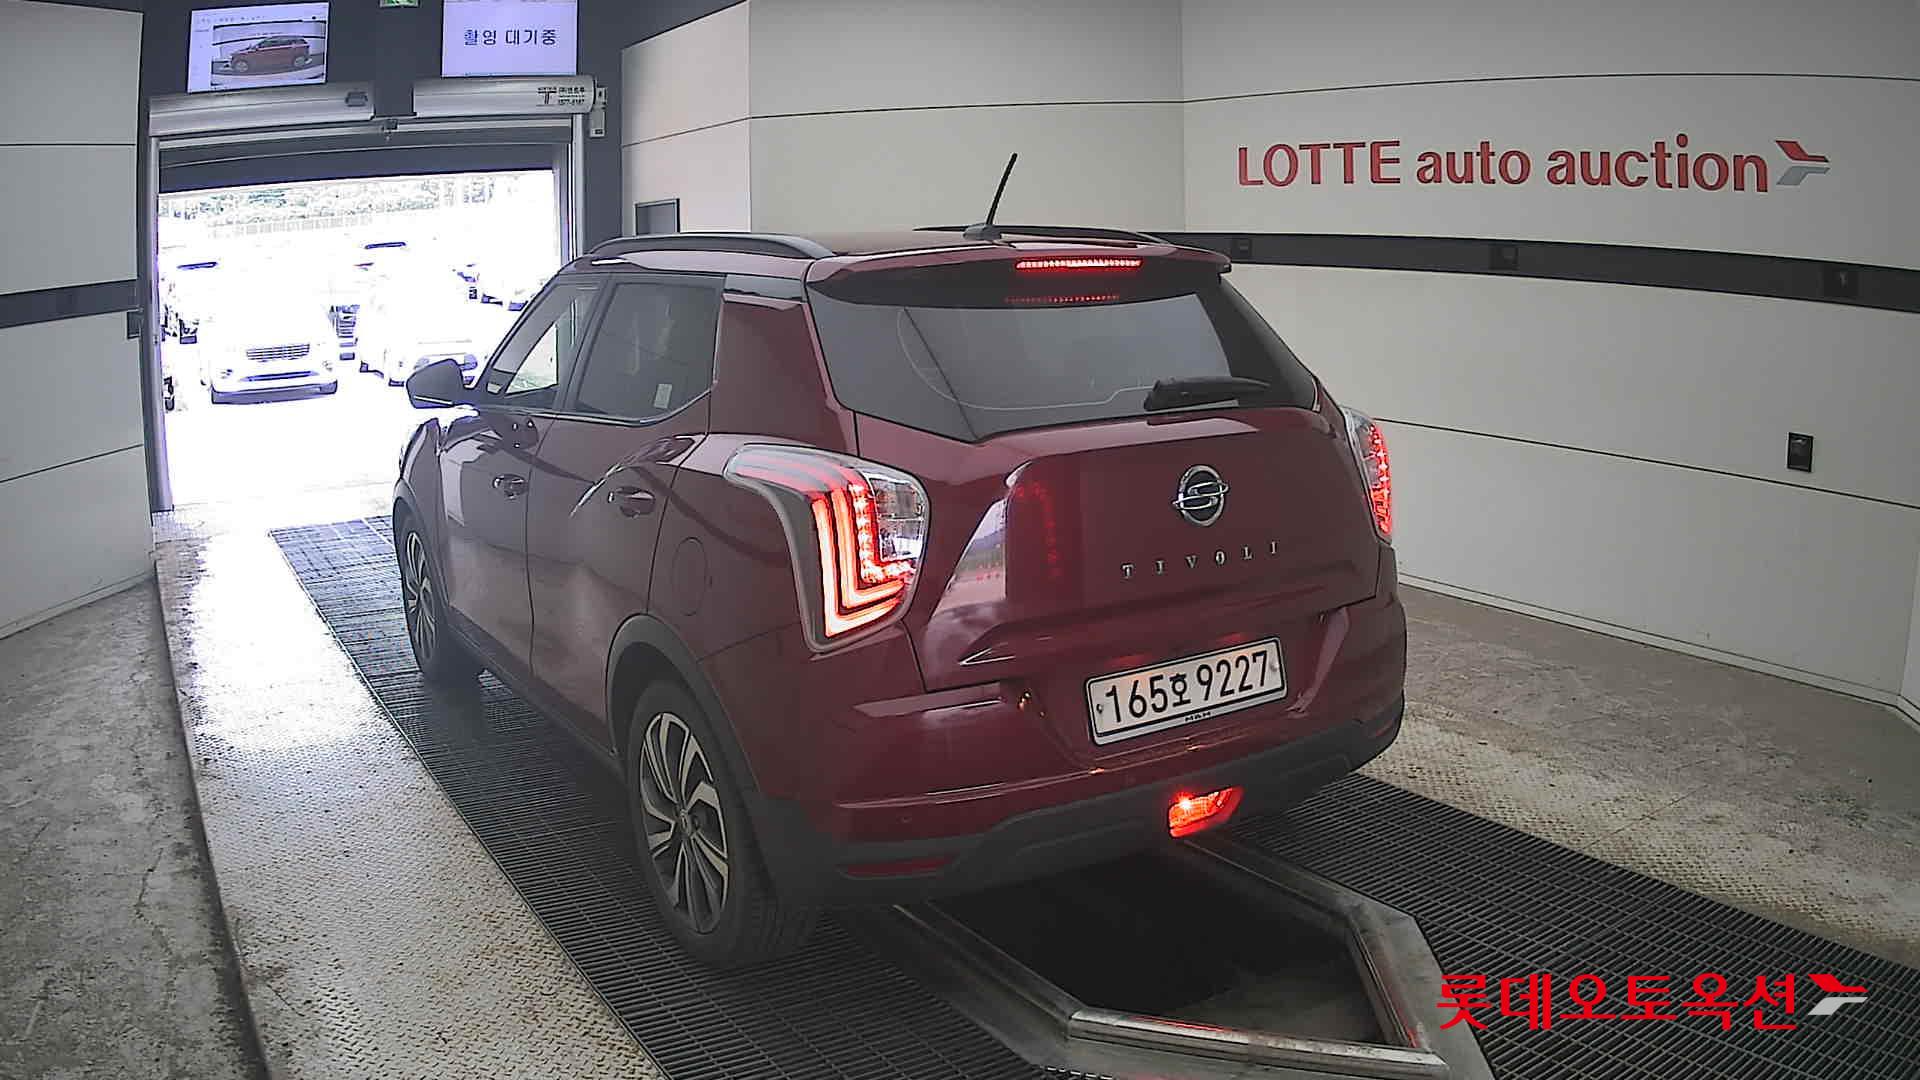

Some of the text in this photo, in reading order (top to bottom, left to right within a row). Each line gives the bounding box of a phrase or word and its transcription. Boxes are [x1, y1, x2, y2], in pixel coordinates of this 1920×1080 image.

[505, 29, 556, 46] 대기중
[1238, 133, 1768, 192] LOTTE auto auction
[1122, 541, 1279, 578] TIVOLI
[1105, 650, 1268, 724] 165호 9227
